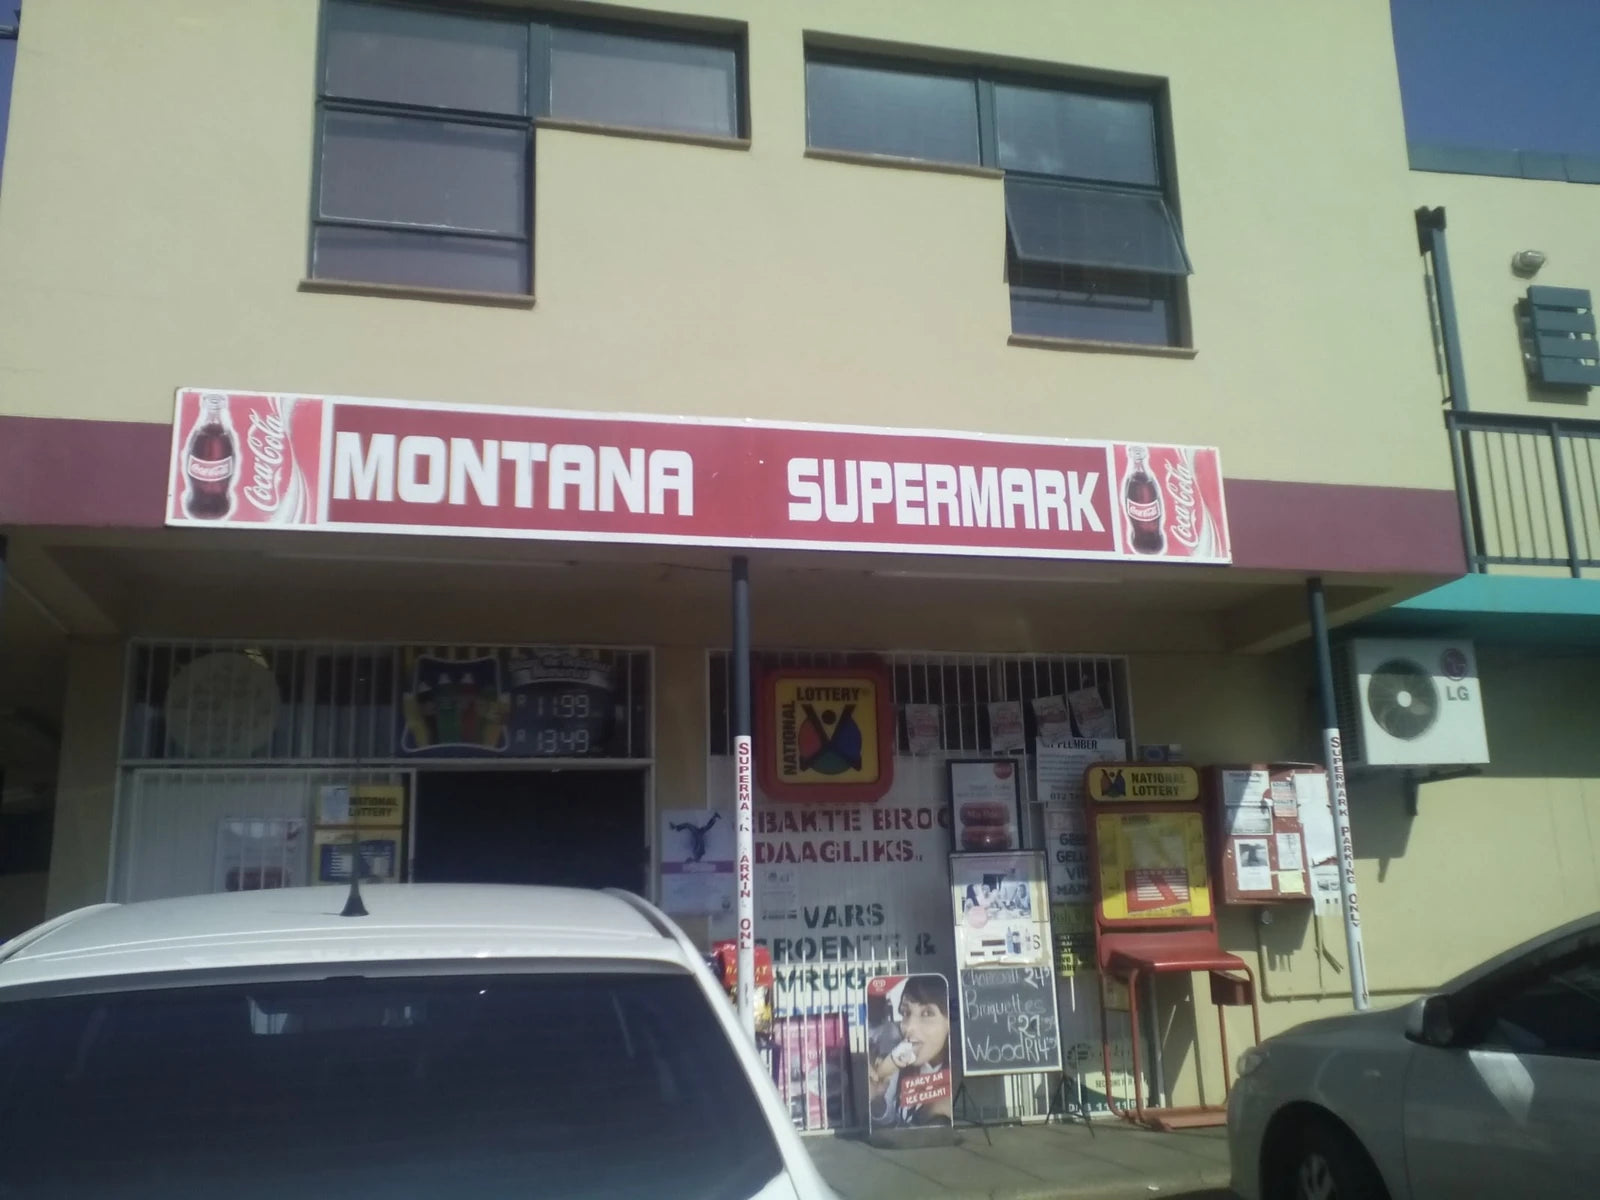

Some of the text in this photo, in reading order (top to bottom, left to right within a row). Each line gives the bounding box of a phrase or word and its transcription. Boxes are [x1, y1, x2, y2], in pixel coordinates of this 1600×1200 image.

[332, 430, 1106, 533] MONTANA SUPERMARK
[796, 687, 860, 701] LOTTERY
[1446, 686, 1469, 701] LG
[782, 700, 797, 776] NATIONAL
[1131, 772, 1186, 784] NATIONAL
[1132, 786, 1179, 796] LOTTERY
[804, 903, 885, 929] VARS
[967, 1032, 1025, 1063] Wood
